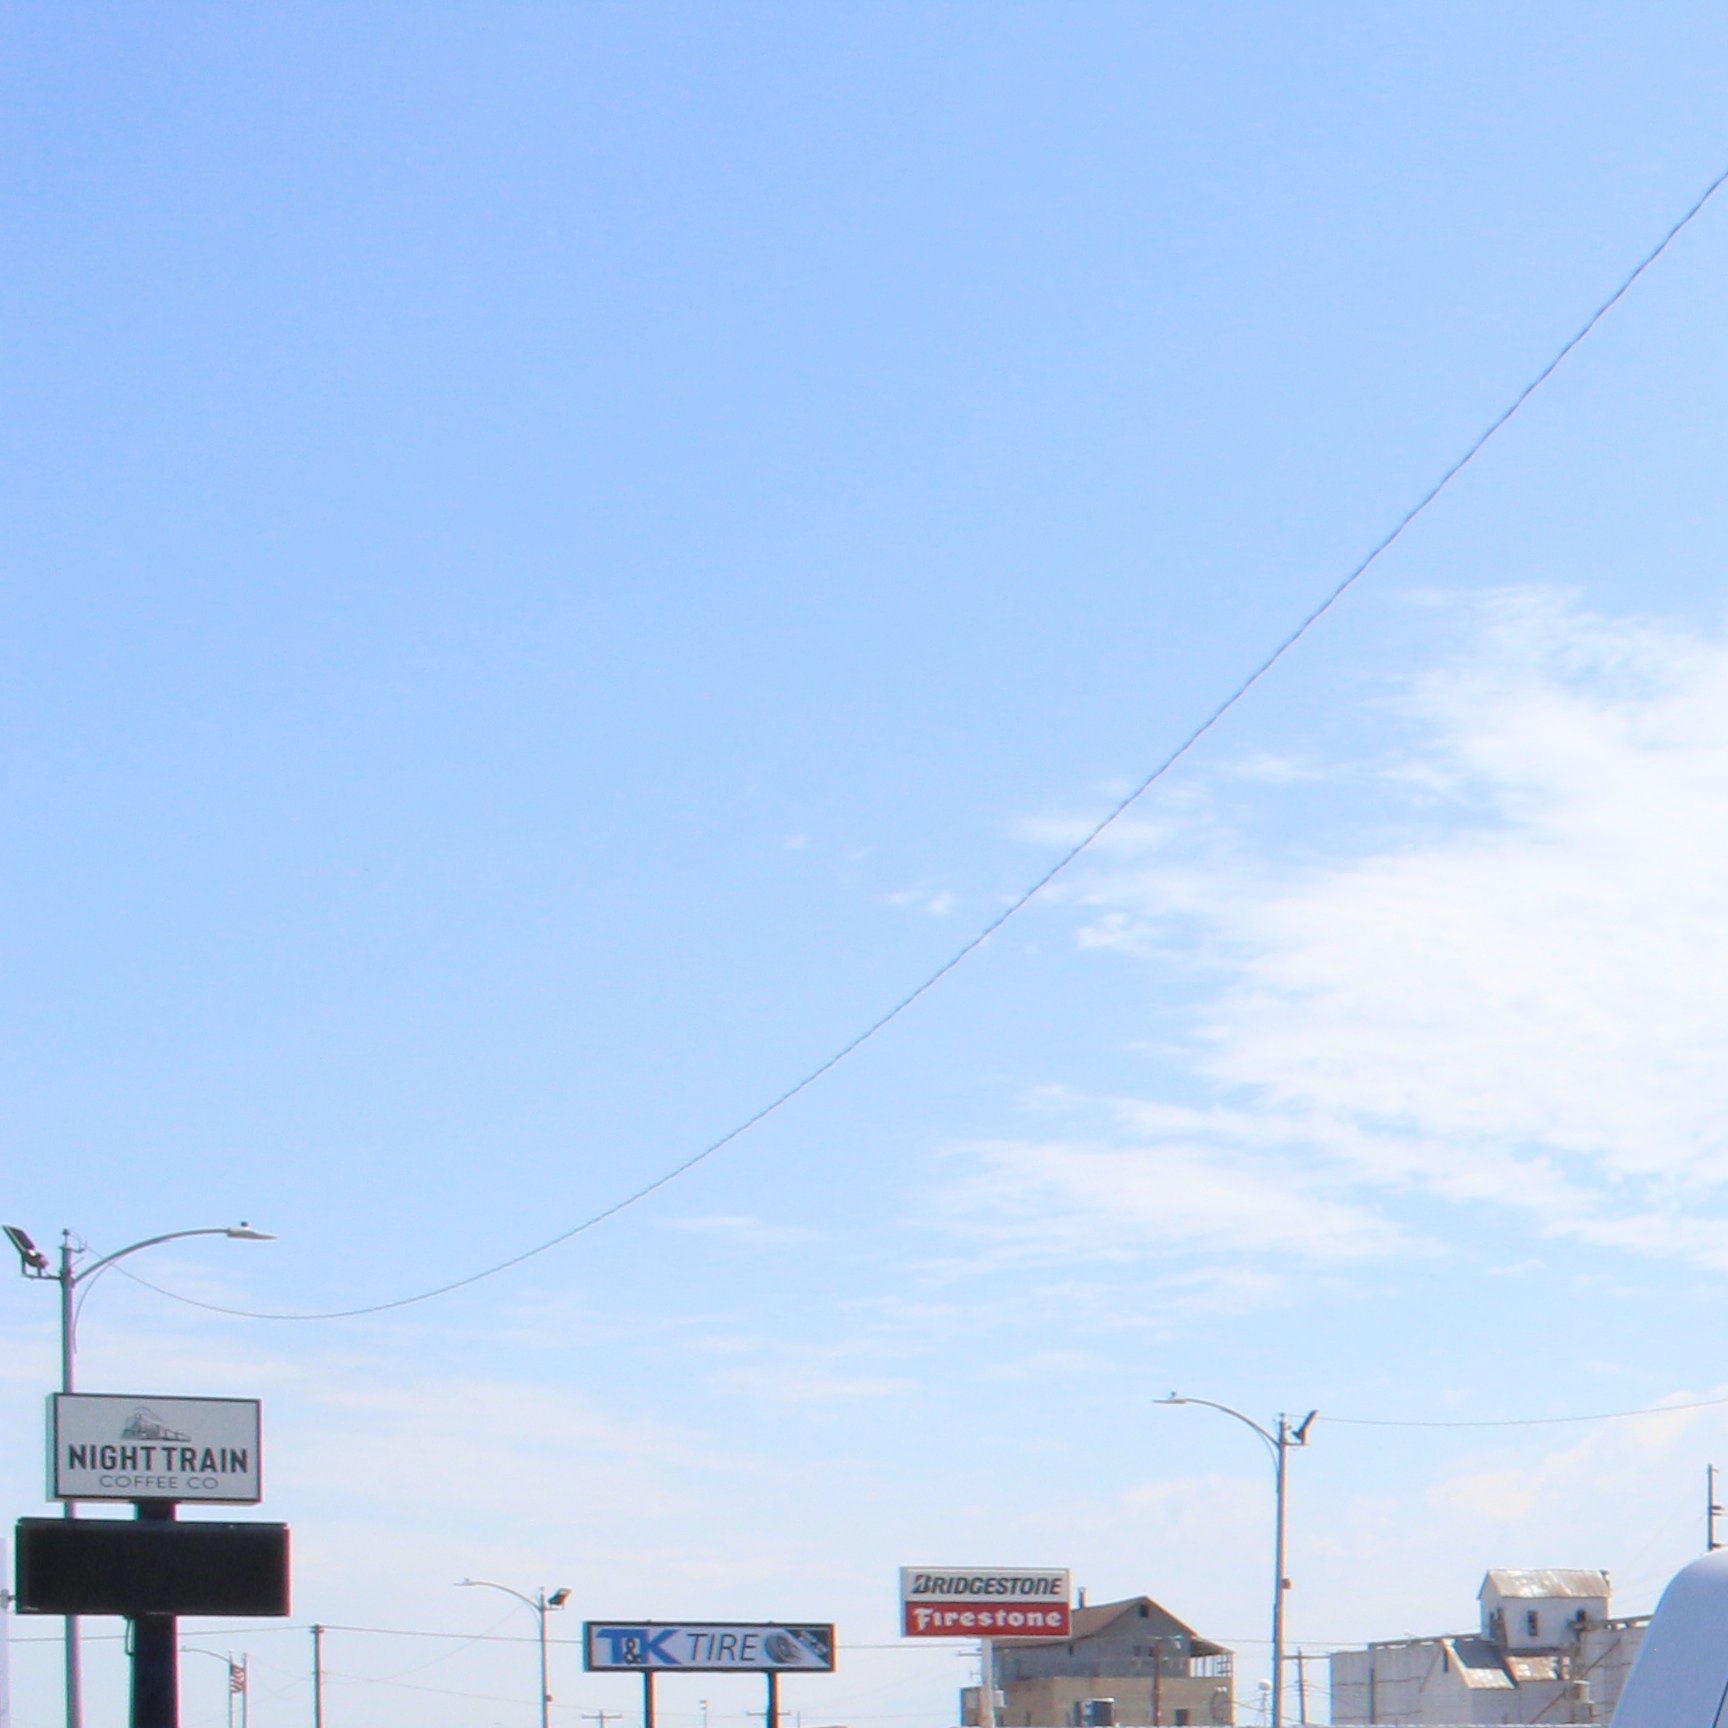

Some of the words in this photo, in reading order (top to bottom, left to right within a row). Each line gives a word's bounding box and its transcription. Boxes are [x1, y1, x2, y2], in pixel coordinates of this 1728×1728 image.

[69, 1444, 155, 1471] NIGHT
[162, 1447, 248, 1473] TRAIN
[101, 1474, 177, 1489] COFFEE
[187, 1477, 218, 1489] CO
[912, 1574, 1062, 1595] BRIDGESTONE
[913, 1607, 1062, 1631] Firestone
[595, 1628, 682, 1665] T&K
[687, 1632, 760, 1662] TIRE
